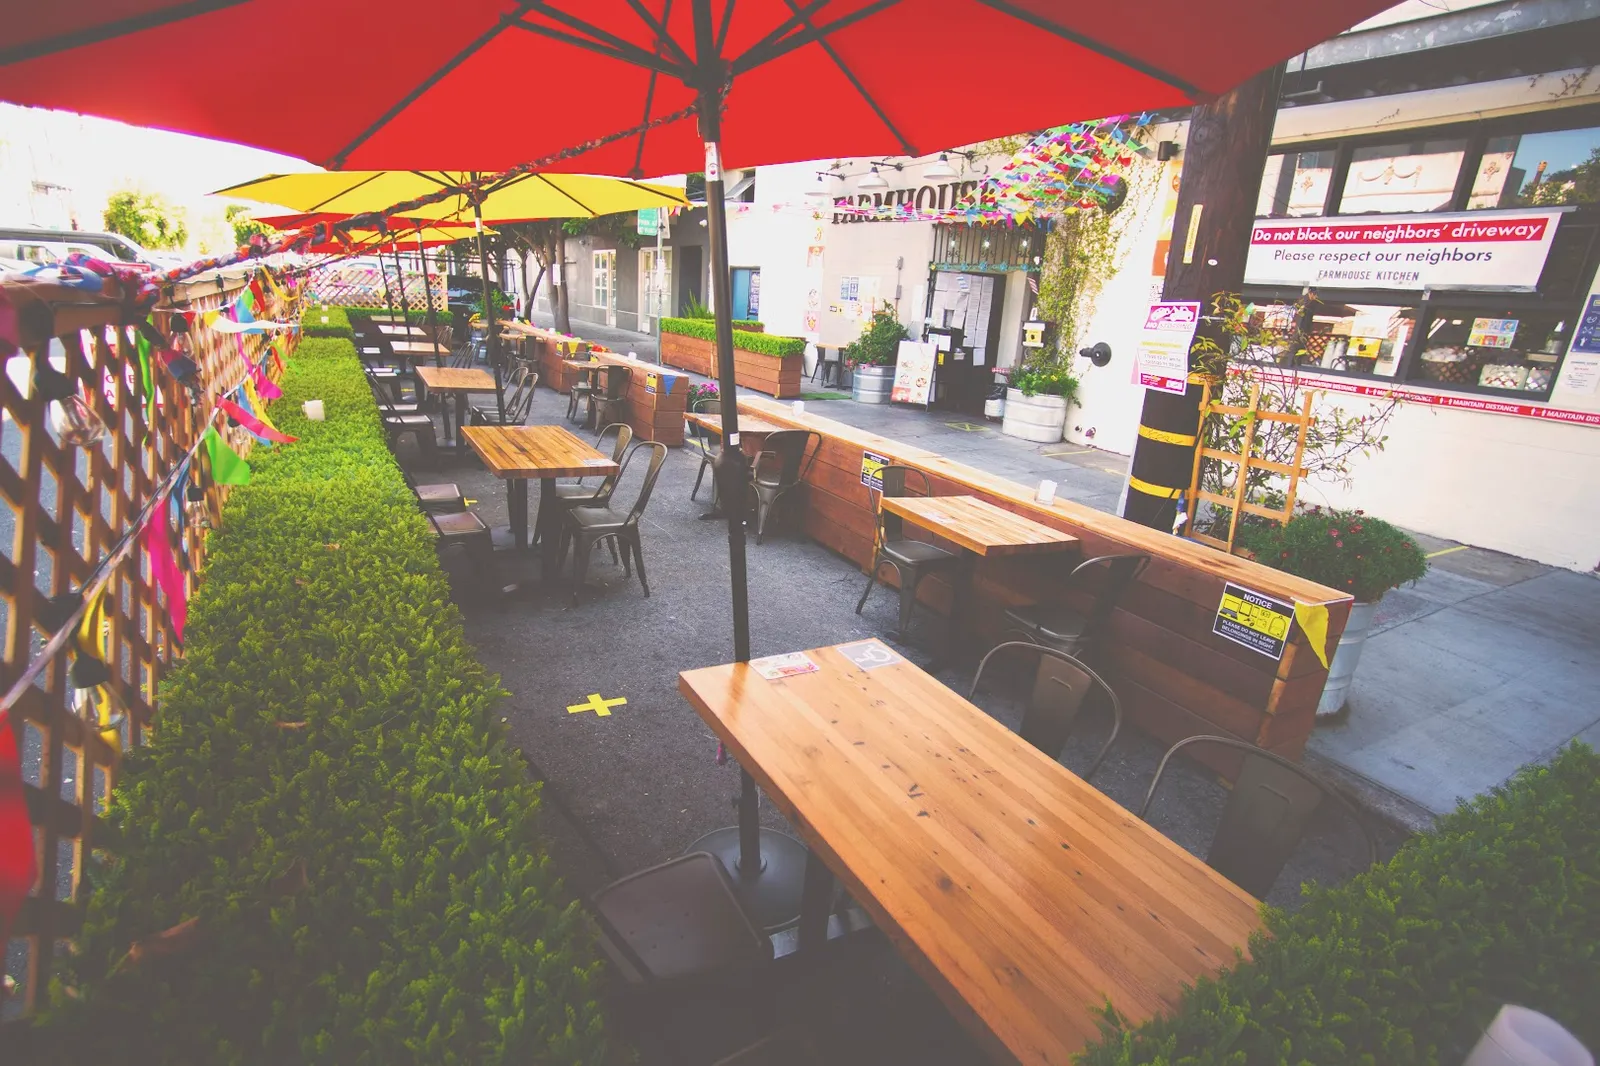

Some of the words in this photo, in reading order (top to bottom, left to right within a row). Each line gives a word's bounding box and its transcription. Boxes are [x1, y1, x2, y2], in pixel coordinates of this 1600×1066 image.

[1254, 229, 1271, 241] Do
[1274, 230, 1295, 241] not
[1297, 227, 1333, 241] block
[1335, 229, 1361, 240] our
[1451, 223, 1542, 240] driveway
[1274, 249, 1315, 261] Please
[1319, 250, 1371, 264] respect
[1375, 252, 1402, 262] our
[1405, 247, 1492, 265] neighbors
[1318, 270, 1371, 280] FARMHOUSE
[1376, 271, 1420, 281] KITCHEN
[1452, 399, 1485, 409] MAINTAIN
[1485, 403, 1519, 413] DISTANCE
[1546, 410, 1585, 421] MAINTAIN
[1243, 593, 1273, 609] NOTICE
[1222, 619, 1240, 631] PLEASE
[1249, 630, 1260, 638] NOT
[1259, 633, 1276, 645] LEAVE
